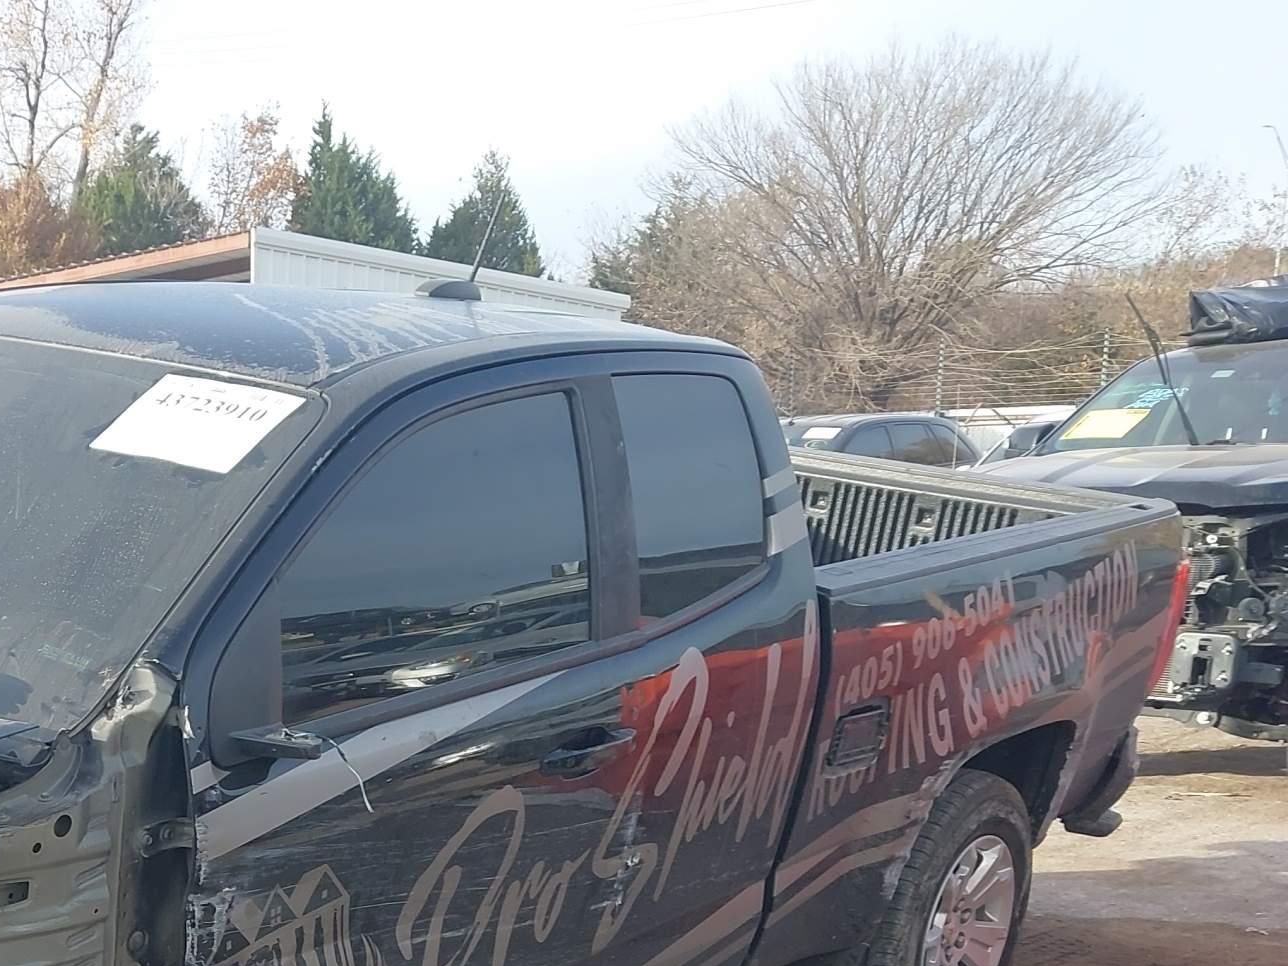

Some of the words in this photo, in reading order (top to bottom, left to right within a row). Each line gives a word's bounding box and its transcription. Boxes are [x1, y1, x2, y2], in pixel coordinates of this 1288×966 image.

[834, 642, 903, 717] (405)
[957, 656, 988, 738] &
[983, 539, 1139, 718] CONSTRUCTION
